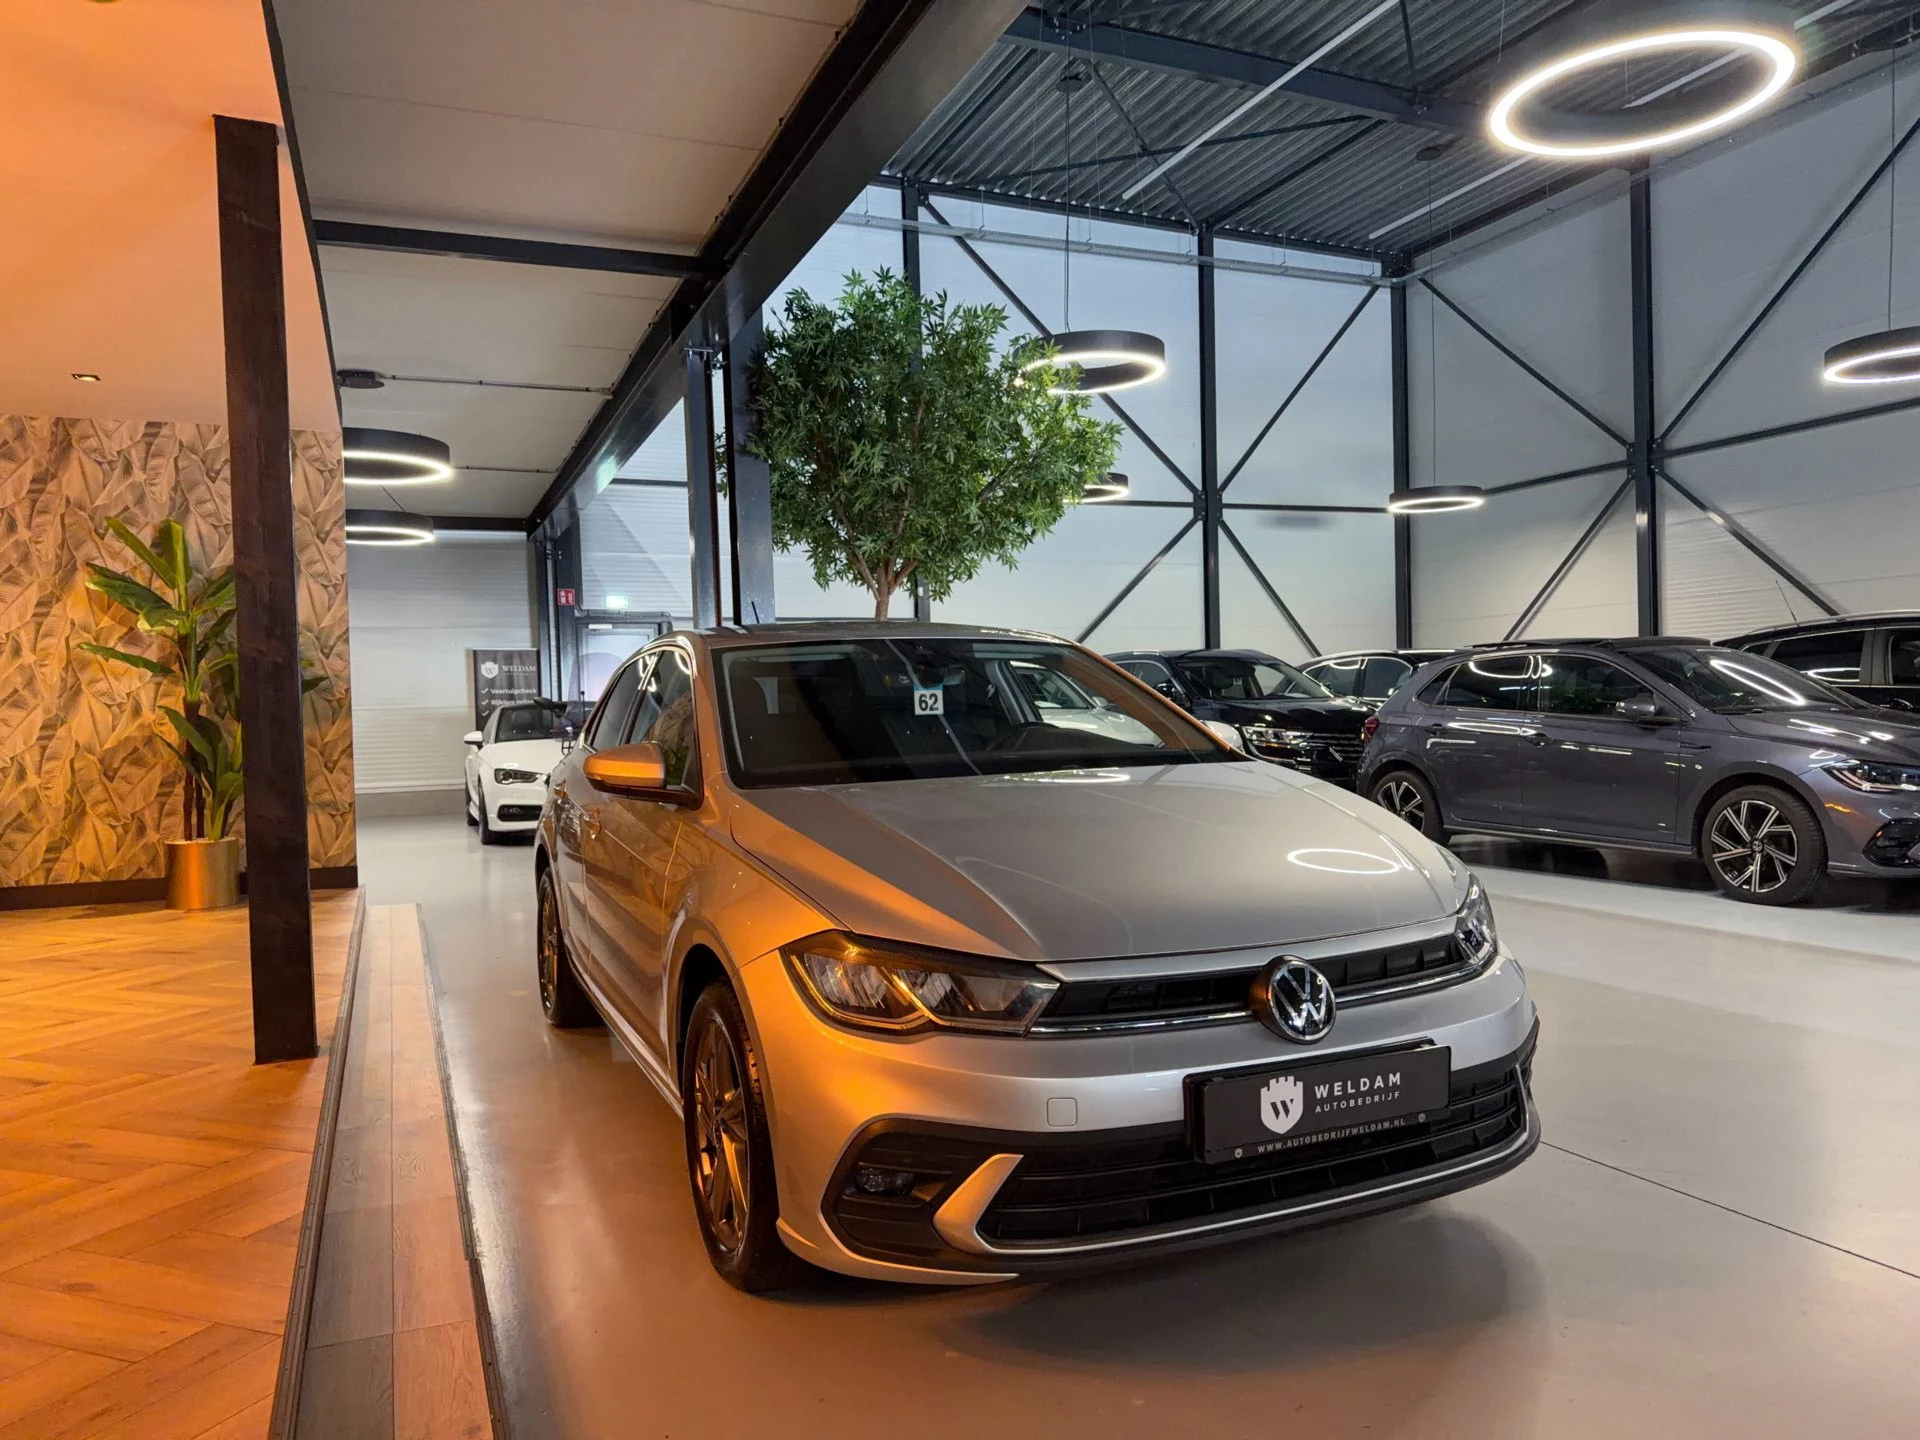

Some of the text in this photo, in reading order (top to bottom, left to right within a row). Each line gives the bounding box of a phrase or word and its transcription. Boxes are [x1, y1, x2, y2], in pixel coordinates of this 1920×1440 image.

[918, 693, 939, 711] 62
[1314, 1071, 1401, 1099] WELDAM
[1270, 1098, 1294, 1121] W
[1314, 1091, 1400, 1113] AUTOBEDRIJF
[1257, 1118, 1406, 1154] WWW.AUTOBEDRIJFWELDAM.NL
